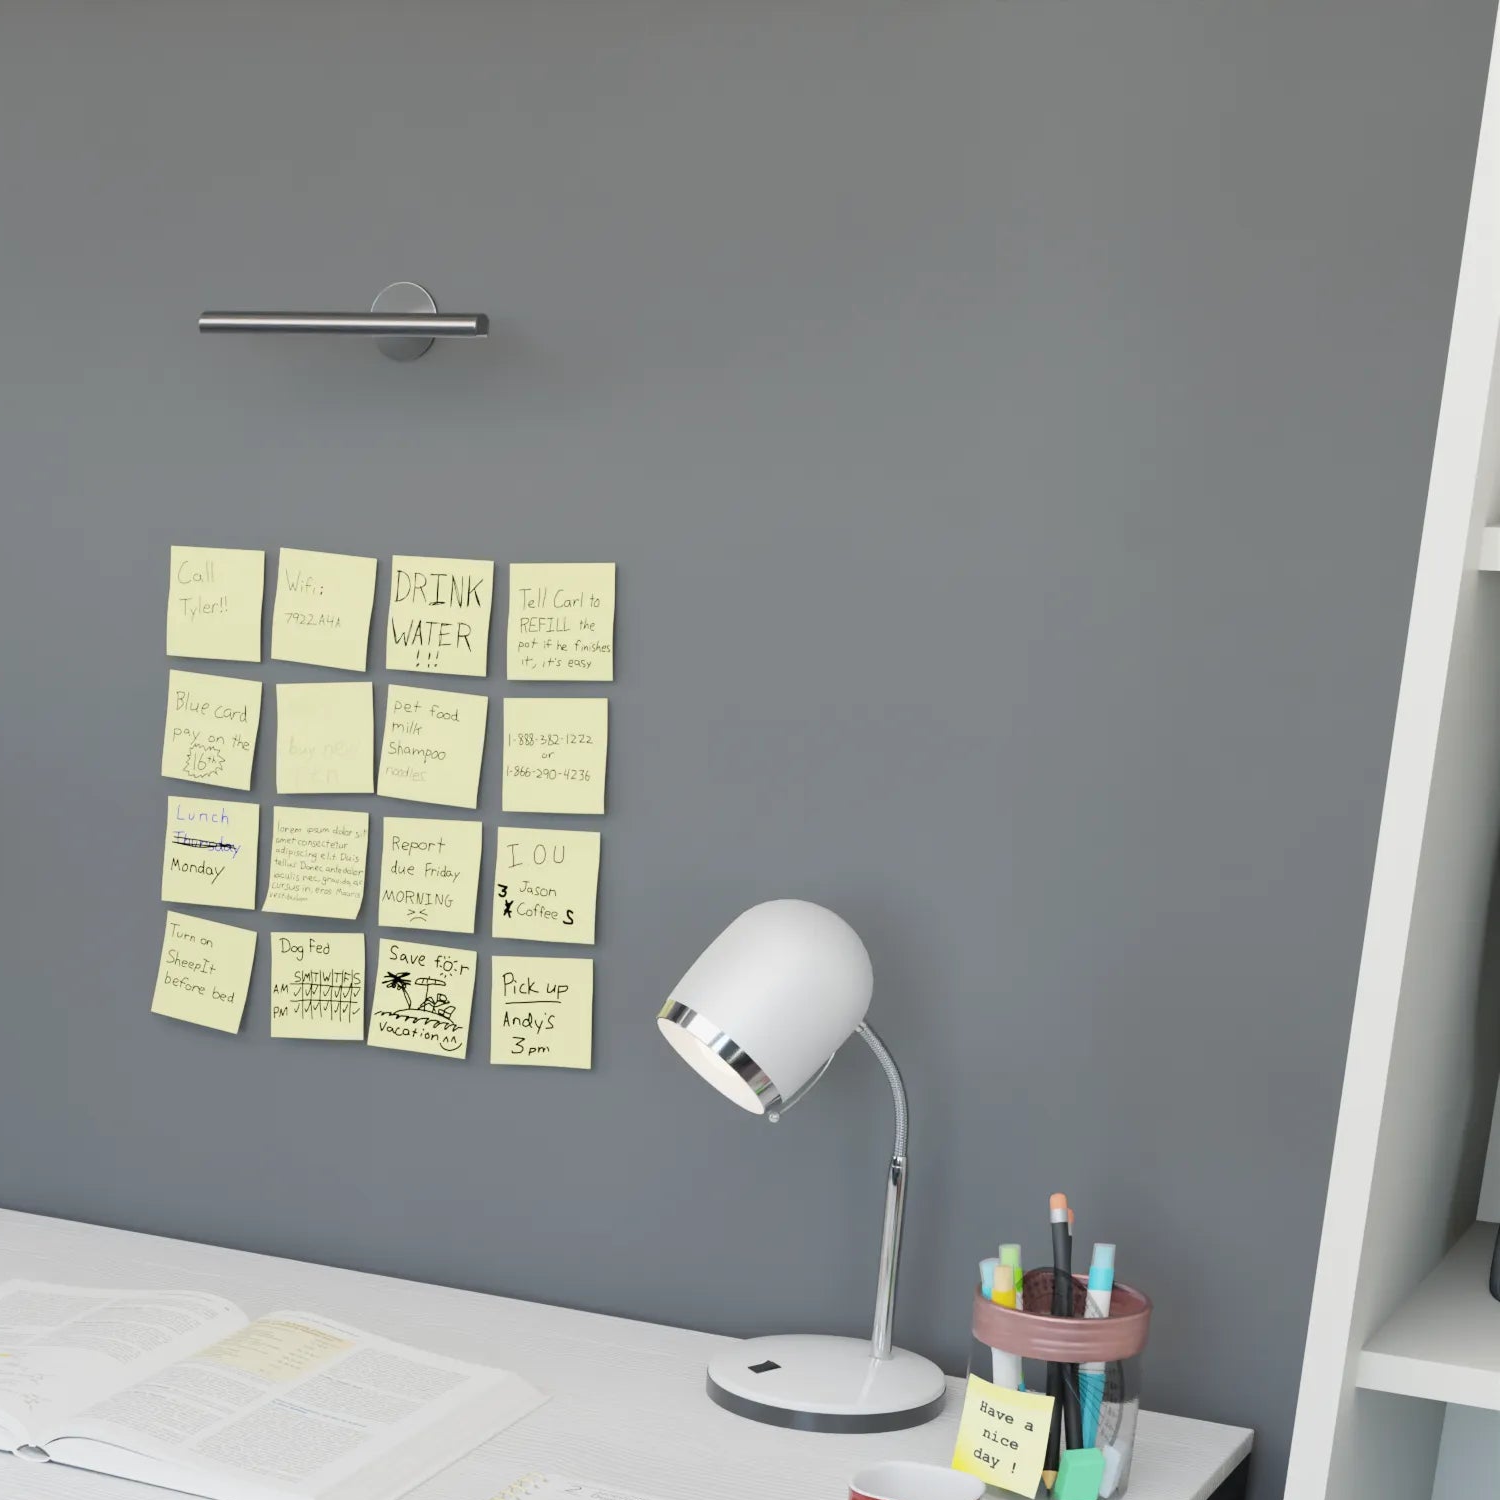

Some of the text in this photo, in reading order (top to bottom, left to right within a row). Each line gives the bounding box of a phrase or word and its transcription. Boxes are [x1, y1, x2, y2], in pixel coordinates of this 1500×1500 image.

[177, 561, 215, 584] Call
[395, 570, 483, 608] DRINK
[519, 588, 601, 610] Tell Carl to
[392, 617, 472, 652] WATER
[520, 617, 596, 632] REFILL the
[518, 638, 611, 653] pot if he finishes
[542, 658, 562, 667] it's
[568, 659, 592, 669] easy
[176, 691, 248, 723] Blue card
[394, 701, 460, 722] pet food
[173, 727, 250, 751] pay on the
[392, 721, 423, 736] milk
[508, 732, 594, 747] 1-888-382-1222
[541, 751, 555, 759] or
[506, 765, 591, 782] 1-866-290-4236
[176, 804, 229, 824] Lunch
[392, 836, 446, 855] Report
[171, 857, 225, 885] Monday
[391, 860, 461, 883] due Friday
[382, 889, 453, 908] MORNING
[519, 881, 557, 897] Jason
[170, 922, 213, 948] Turn on
[279, 938, 304, 961] Dog
[389, 945, 426, 967] Save
[165, 971, 235, 1003] before bed
[273, 984, 289, 994] AM
[502, 972, 569, 999] Pick up
[273, 1006, 288, 1017] PM
[980, 1400, 1034, 1432] Have a
[982, 1427, 1019, 1451] nice
[973, 1448, 1000, 1469] day
